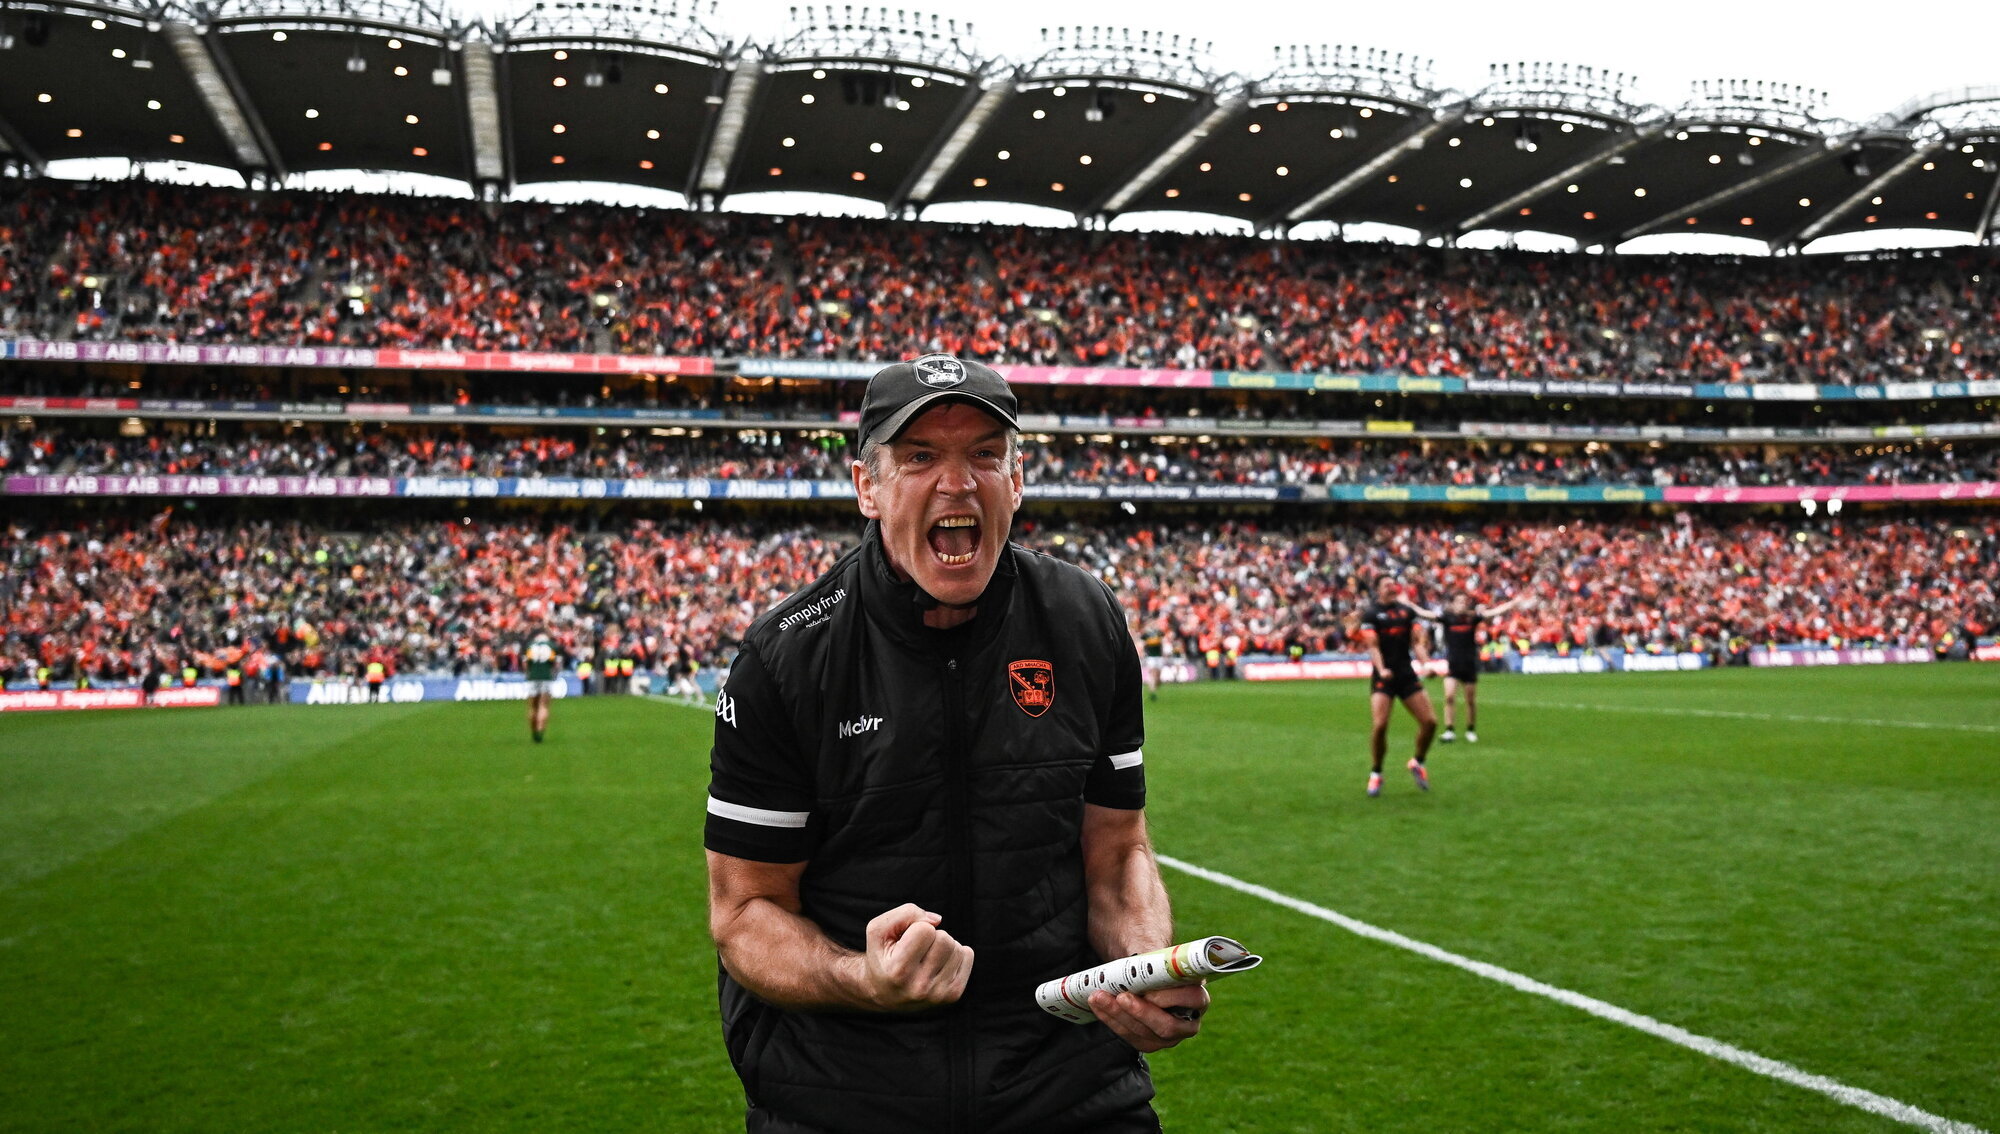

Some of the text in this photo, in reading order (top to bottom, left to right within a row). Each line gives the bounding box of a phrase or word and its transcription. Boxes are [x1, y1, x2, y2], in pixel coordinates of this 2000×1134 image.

[44, 342, 77, 359] AIB
[106, 343, 138, 360] AIB
[167, 345, 199, 362] AIB
[227, 347, 258, 363] AIB
[285, 348, 317, 364] AIB
[343, 349, 375, 365] AIB
[65, 476, 98, 494] AIB
[126, 476, 160, 494] AIB
[187, 477, 220, 494] AIB
[247, 477, 279, 495] AIB
[306, 477, 337, 495] AIB
[358, 477, 390, 495] AIB
[404, 477, 472, 497] Allianz
[515, 478, 579, 497] Allianz
[622, 479, 685, 498] Allianz
[725, 479, 787, 498] Allianz
